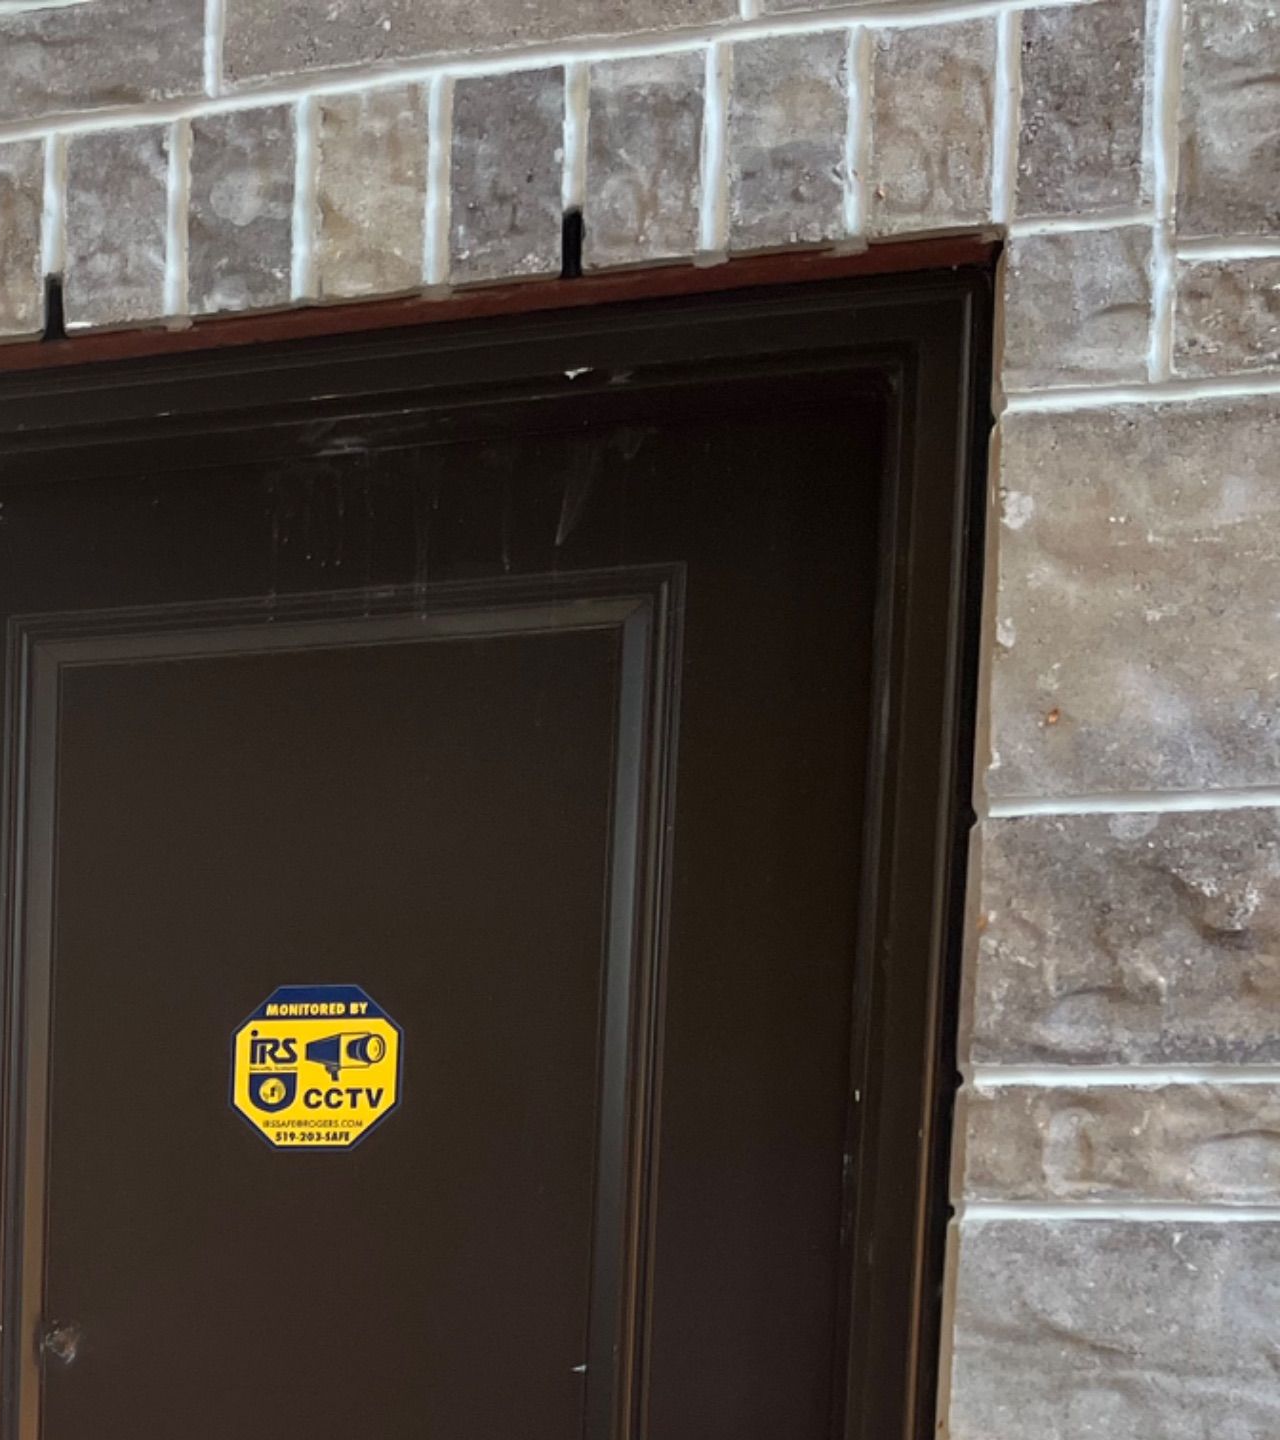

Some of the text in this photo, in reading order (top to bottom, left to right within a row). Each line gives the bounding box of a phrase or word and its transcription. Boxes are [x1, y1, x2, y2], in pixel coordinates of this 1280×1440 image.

[266, 1002, 368, 1016] MONITORED BY
[303, 1088, 384, 1109] CCTV
[275, 1131, 350, 1142] 519-203-SAFE
